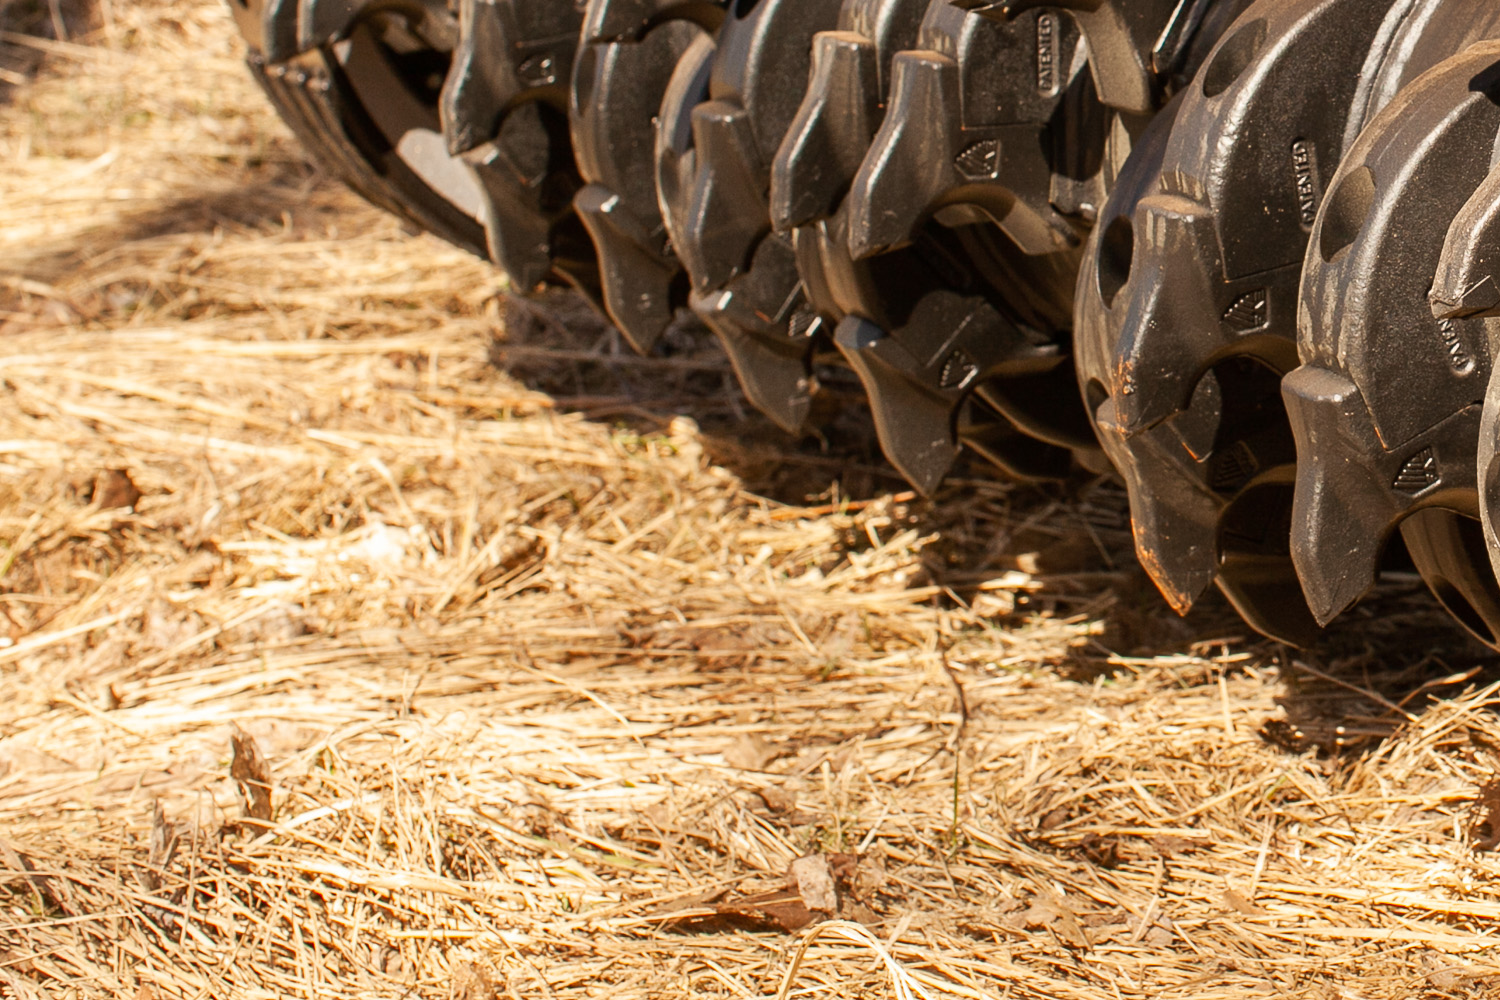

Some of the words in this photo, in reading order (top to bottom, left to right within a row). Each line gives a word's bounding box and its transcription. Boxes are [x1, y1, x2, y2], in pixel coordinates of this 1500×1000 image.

[1037, 13, 1053, 91] PATENTED
[1292, 141, 1316, 224] PATENTED
[1437, 318, 1467, 367] PATEN
